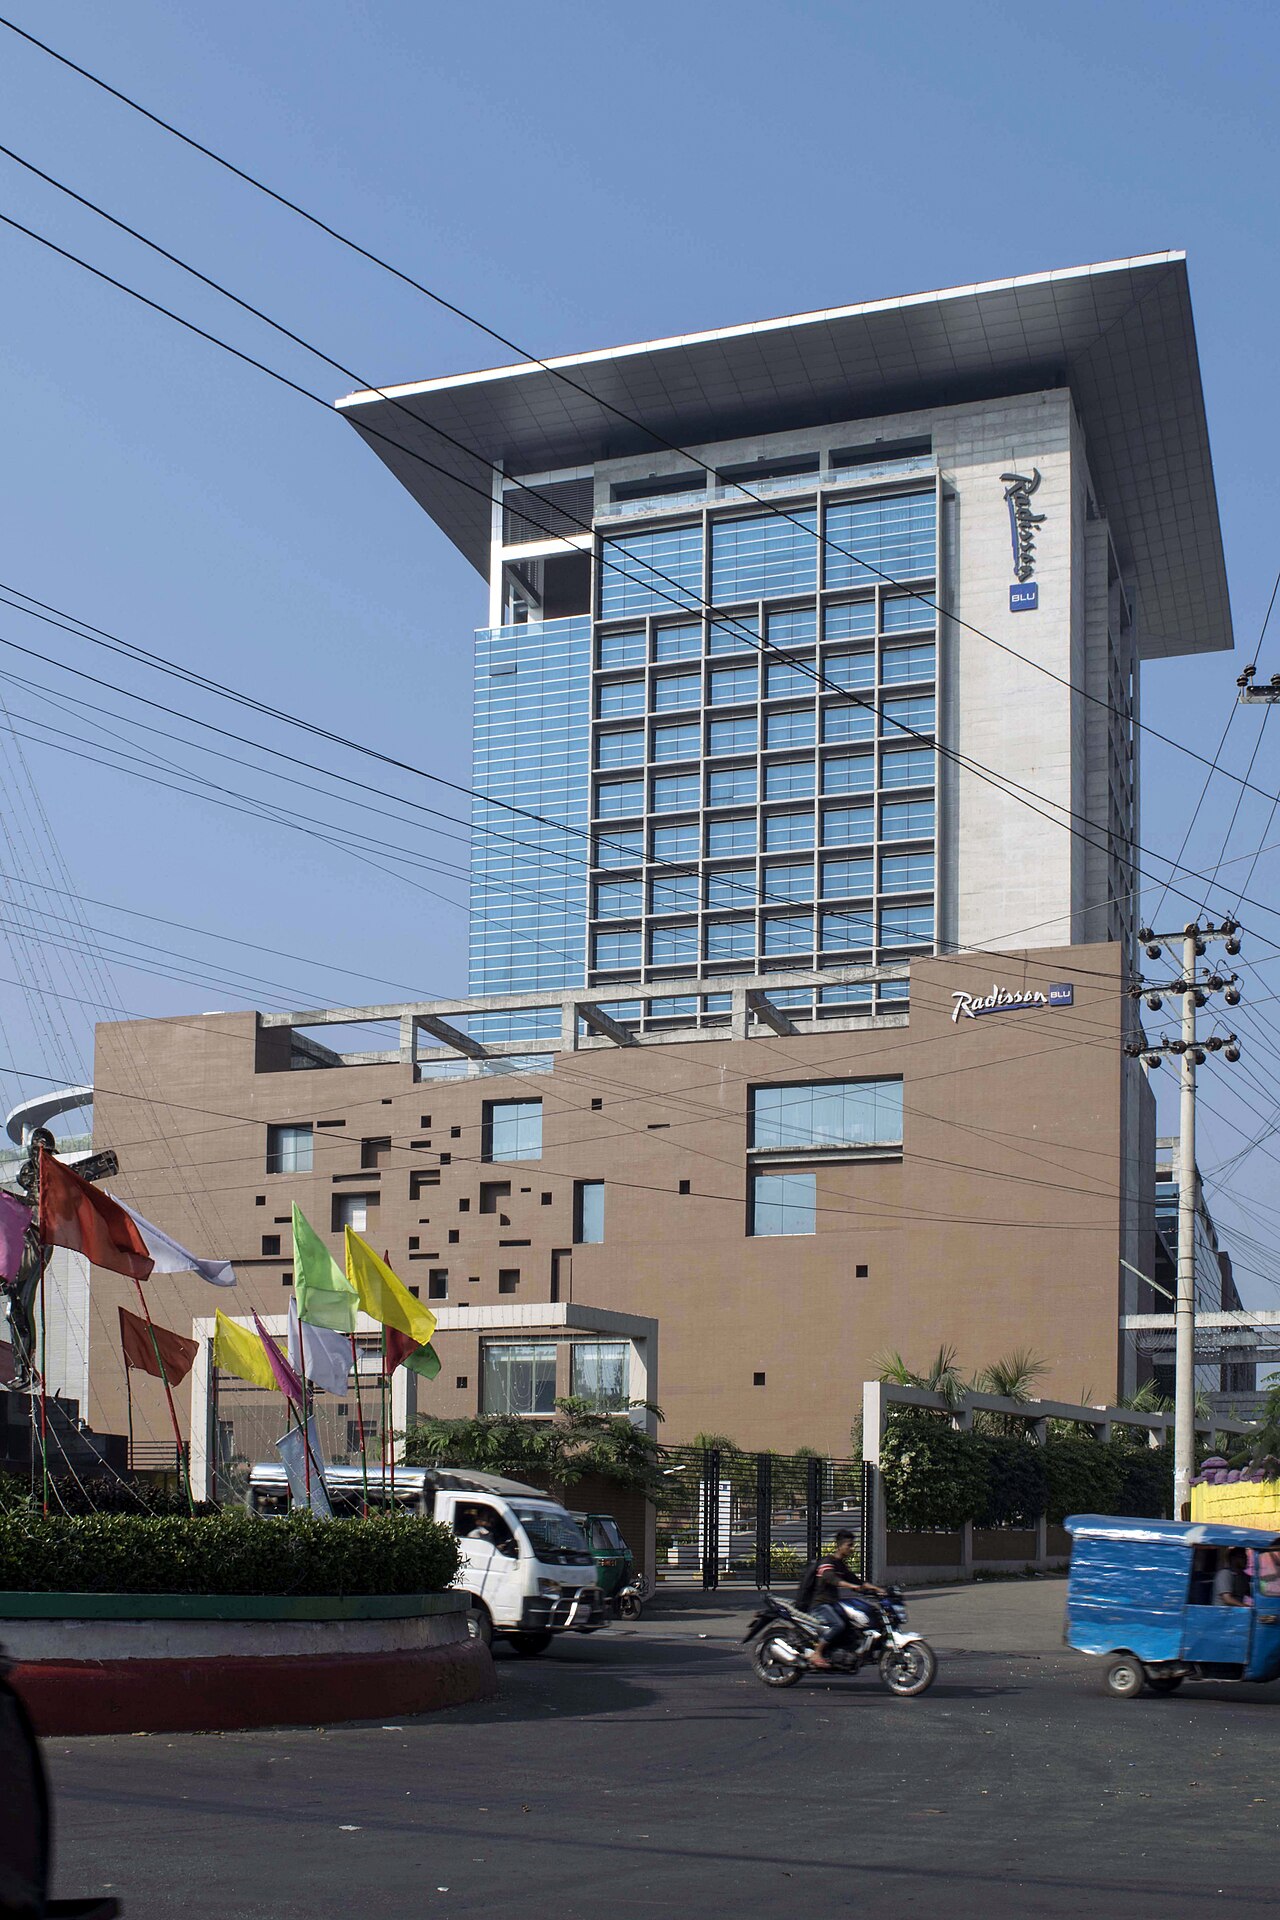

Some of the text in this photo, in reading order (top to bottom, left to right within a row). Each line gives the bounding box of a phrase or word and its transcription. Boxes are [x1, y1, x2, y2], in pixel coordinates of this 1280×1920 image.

[999, 467, 1046, 583] Radisson
[1012, 592, 1036, 602] BLU
[952, 984, 1070, 1022] Radisson BLU
